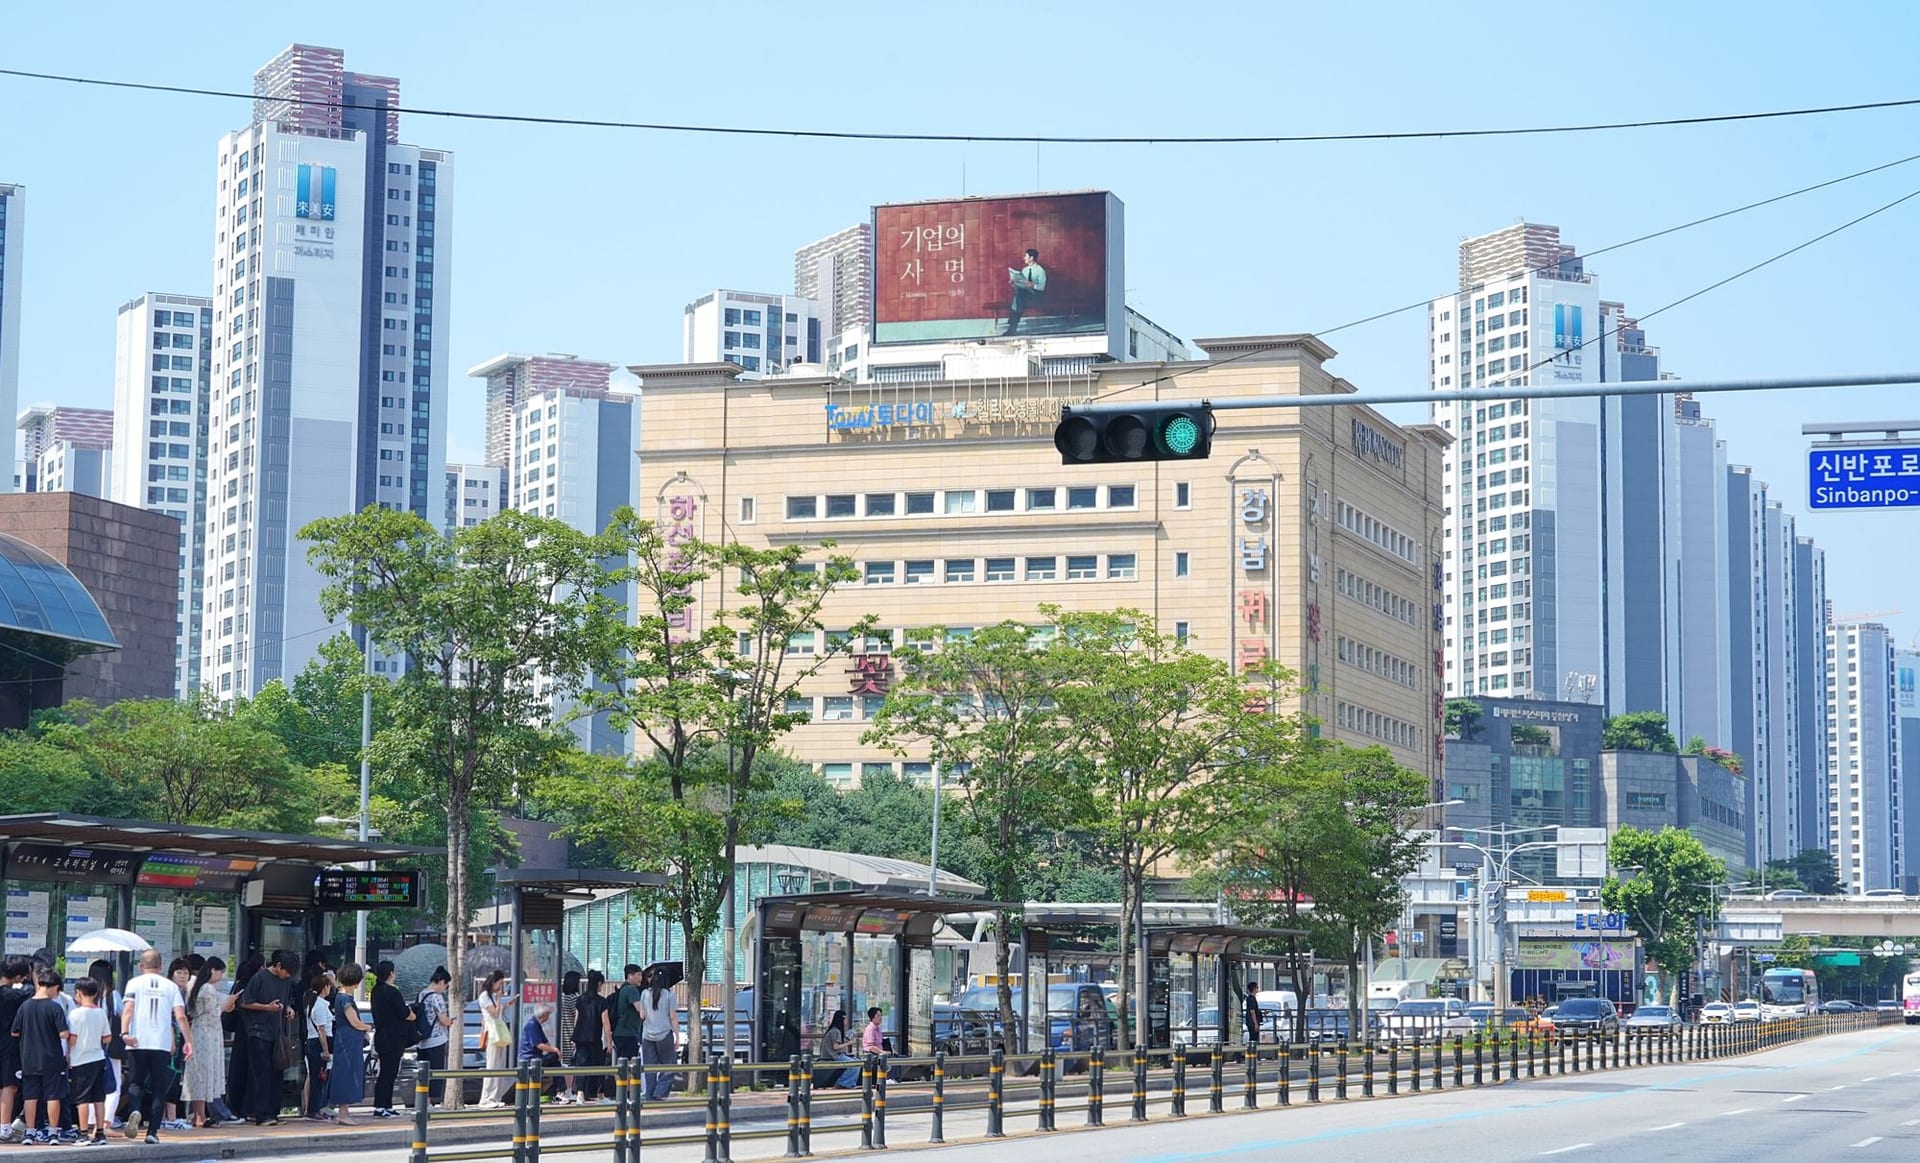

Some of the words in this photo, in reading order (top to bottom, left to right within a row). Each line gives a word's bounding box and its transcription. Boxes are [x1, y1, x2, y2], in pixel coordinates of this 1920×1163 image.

[900, 223, 964, 253] 기업의
[876, 400, 935, 425] 토다이
[1816, 453, 1920, 482] 신반포로
